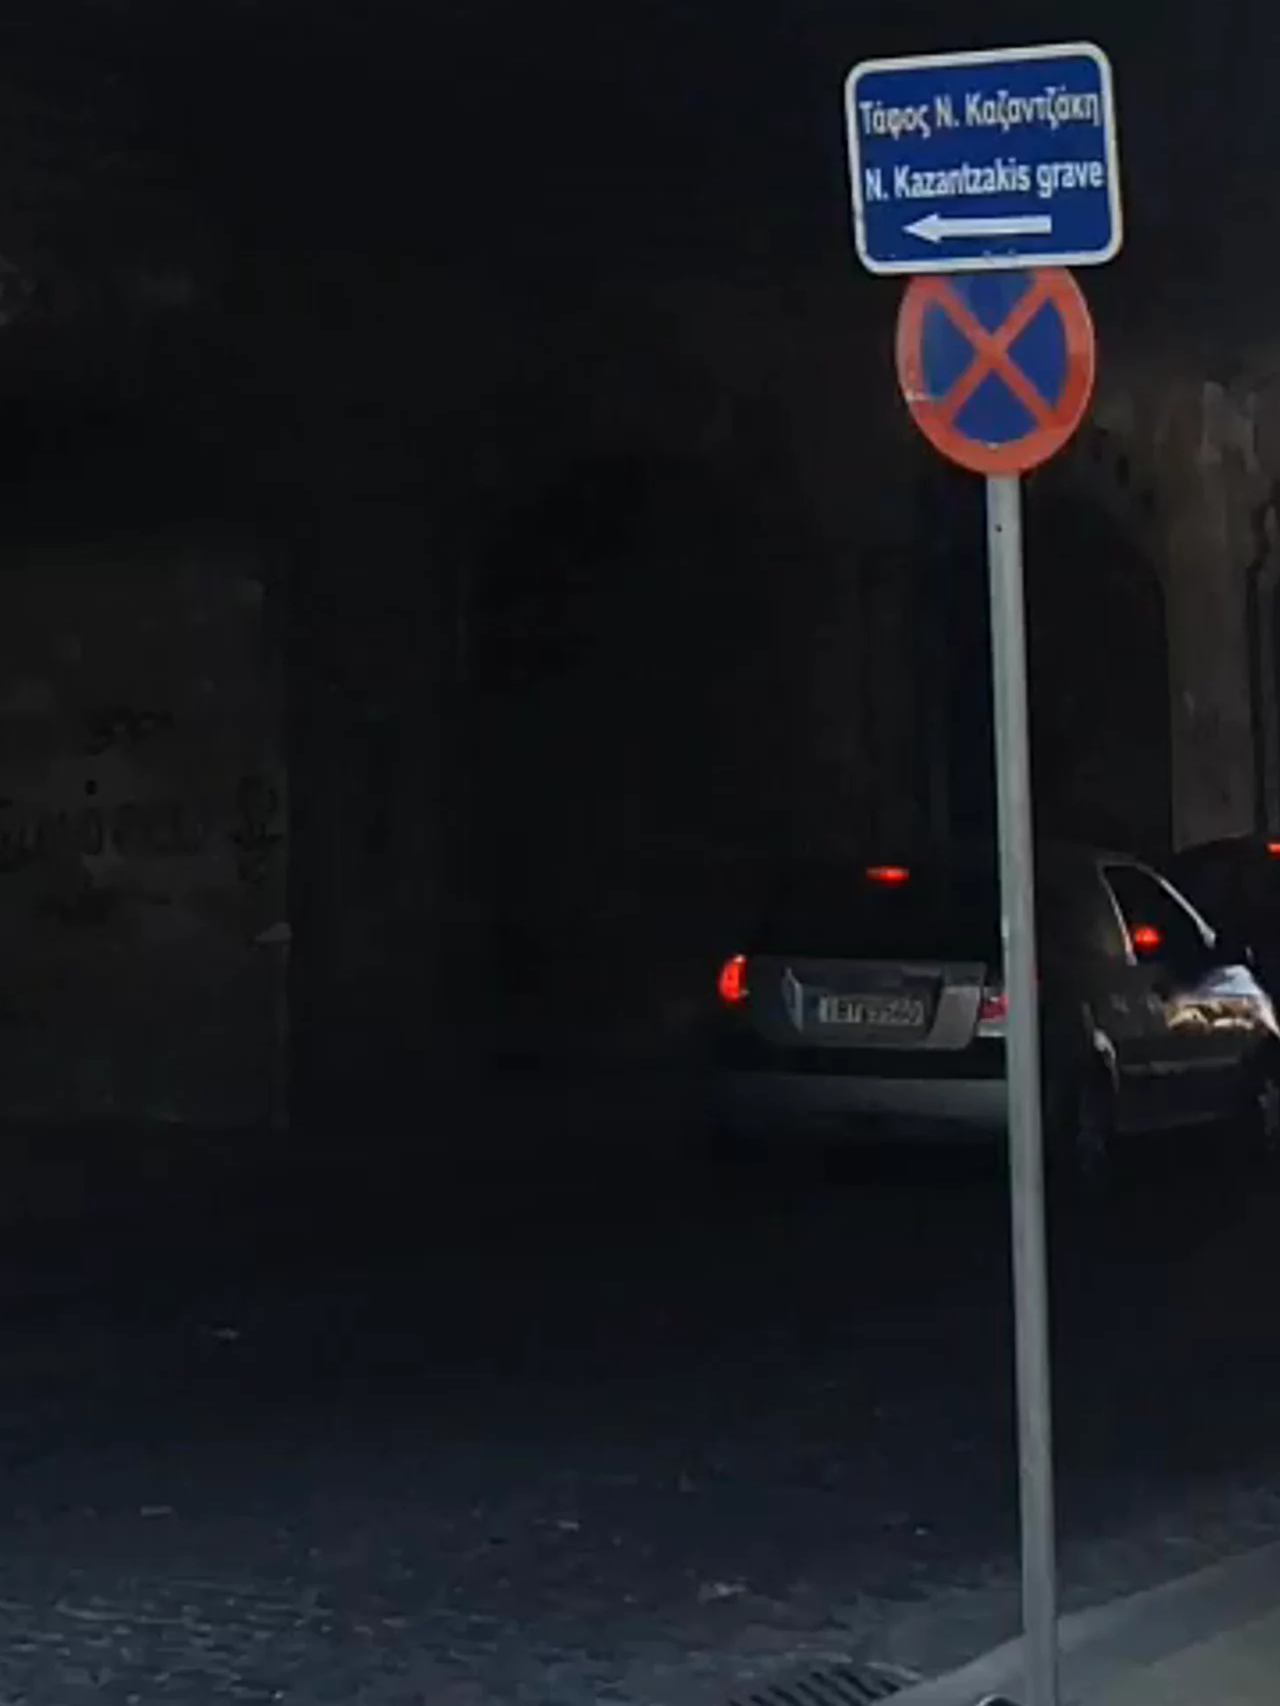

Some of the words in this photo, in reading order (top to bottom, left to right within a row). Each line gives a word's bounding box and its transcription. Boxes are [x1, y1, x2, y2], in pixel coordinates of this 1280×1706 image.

[859, 100, 932, 140] Τάφος
[965, 85, 1102, 133] Καζαντζάκη
[865, 168, 890, 201] N.
[893, 156, 1031, 199] Kazantzakis
[1036, 160, 1104, 199] grave
